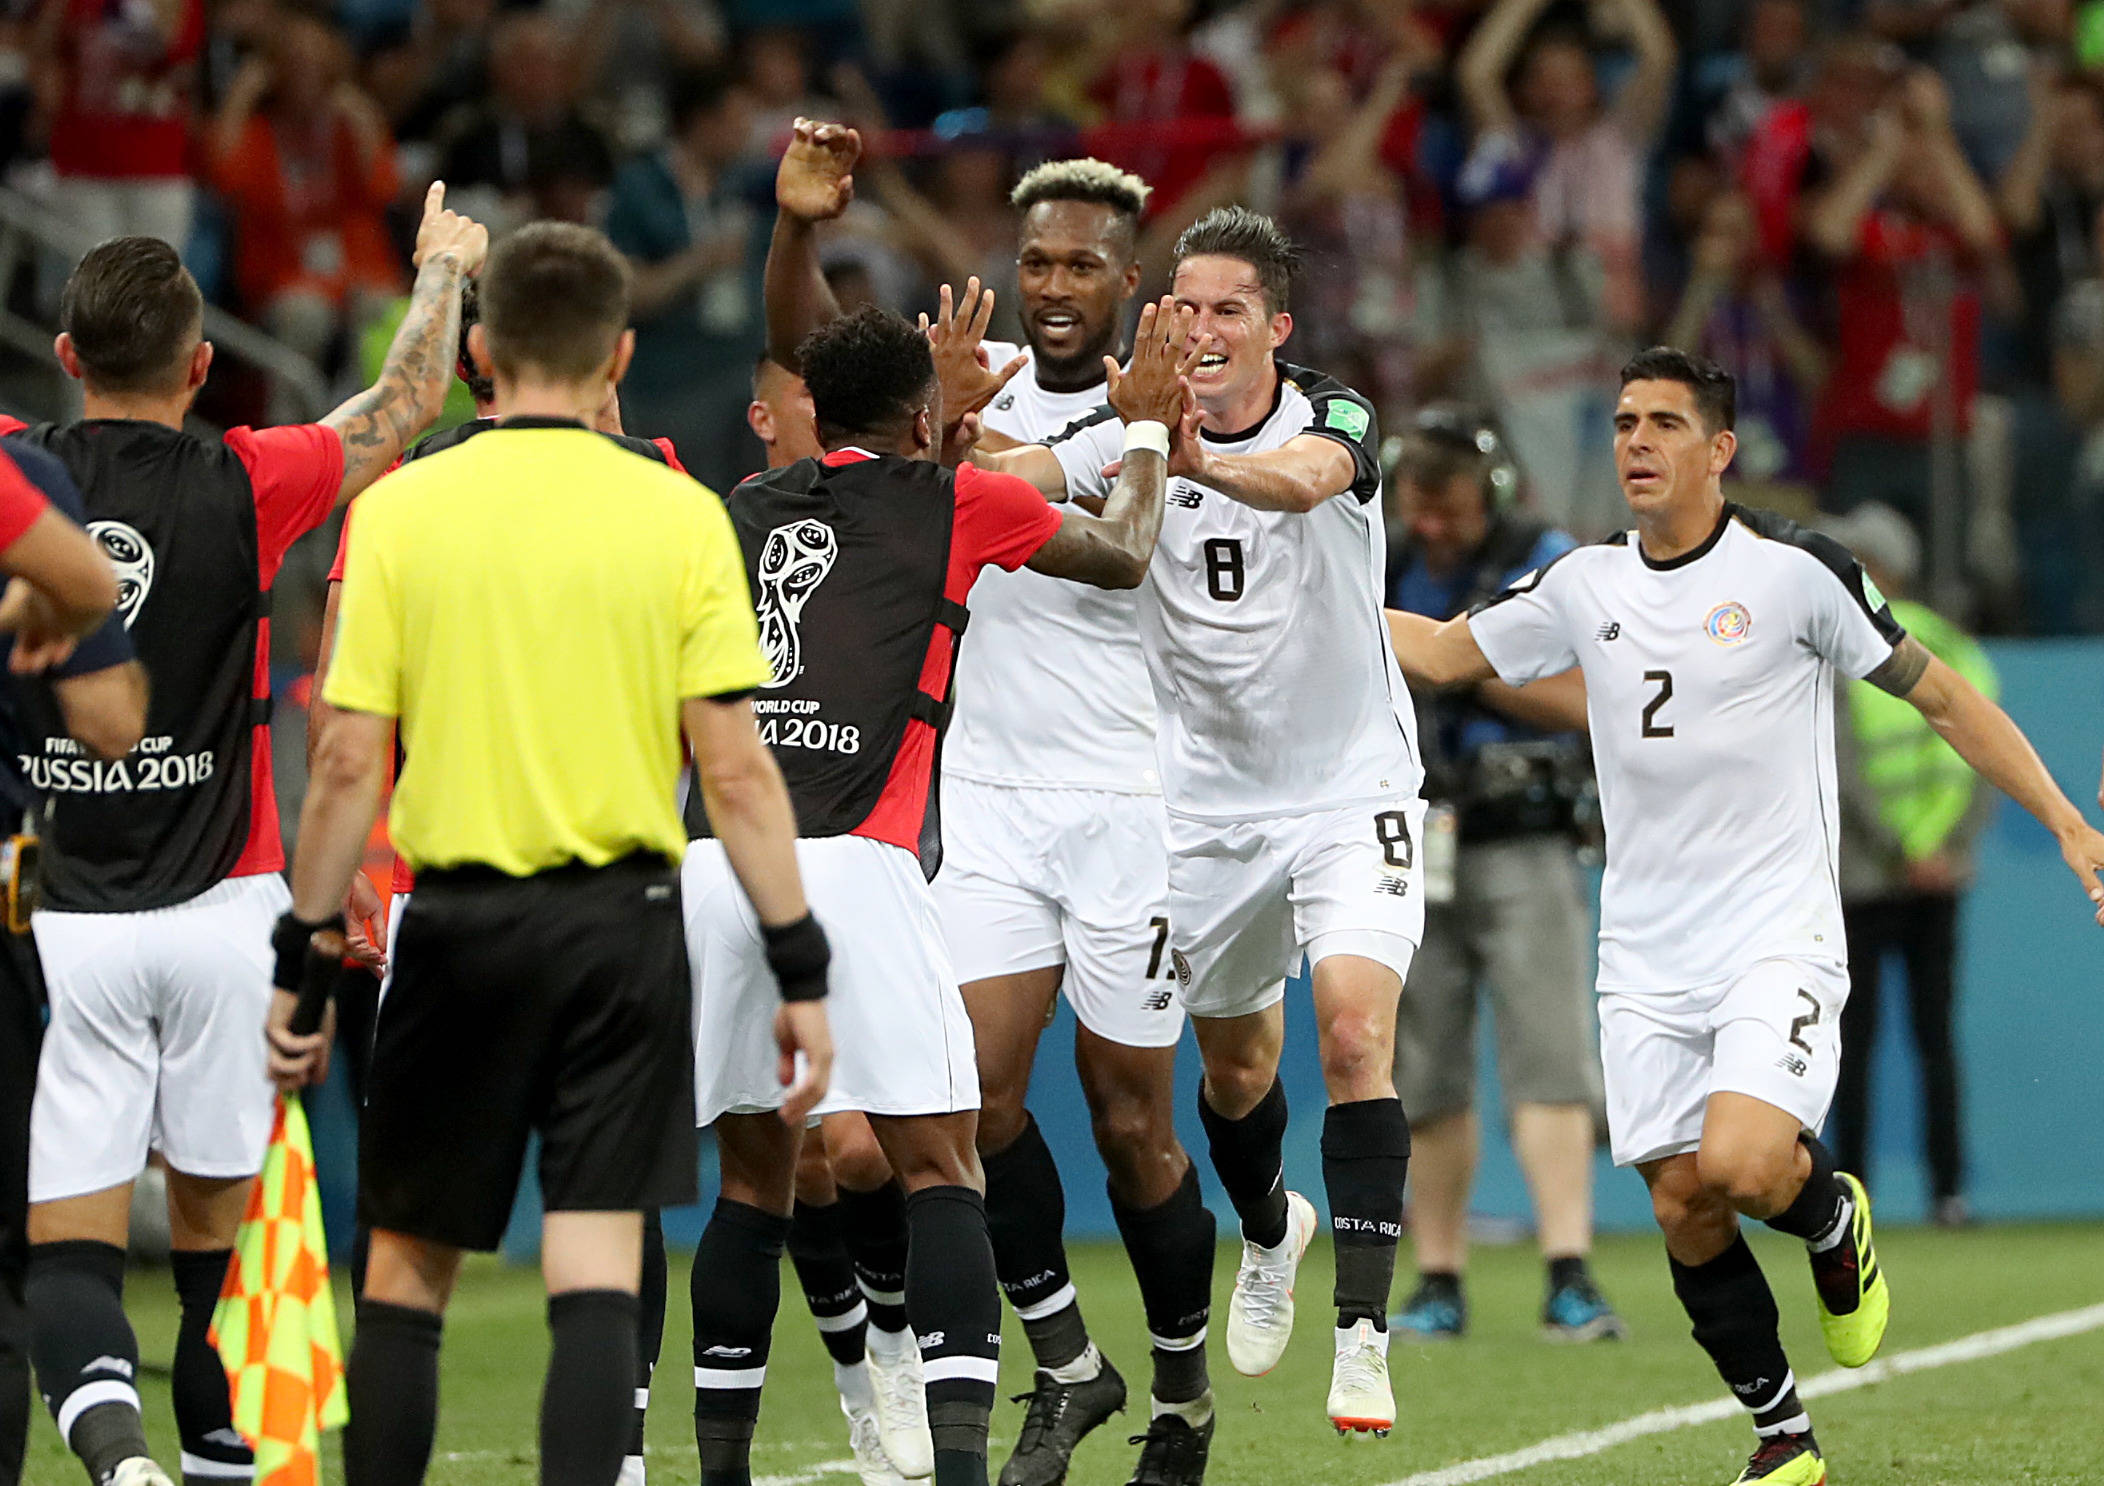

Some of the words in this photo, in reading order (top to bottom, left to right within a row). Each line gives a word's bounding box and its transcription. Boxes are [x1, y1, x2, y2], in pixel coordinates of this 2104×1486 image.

[1204, 538, 1245, 602] 8
[791, 700, 820, 714] CUP
[1641, 670, 1674, 738] 2
[45, 737, 76, 754] FIFA
[139, 736, 173, 753] CUP
[780, 719, 860, 754] 2018
[136, 751, 215, 791] 2018
[1374, 810, 1413, 870] 8
[1788, 987, 1820, 1056] 2
[1023, 1269, 1056, 1289] RICA
